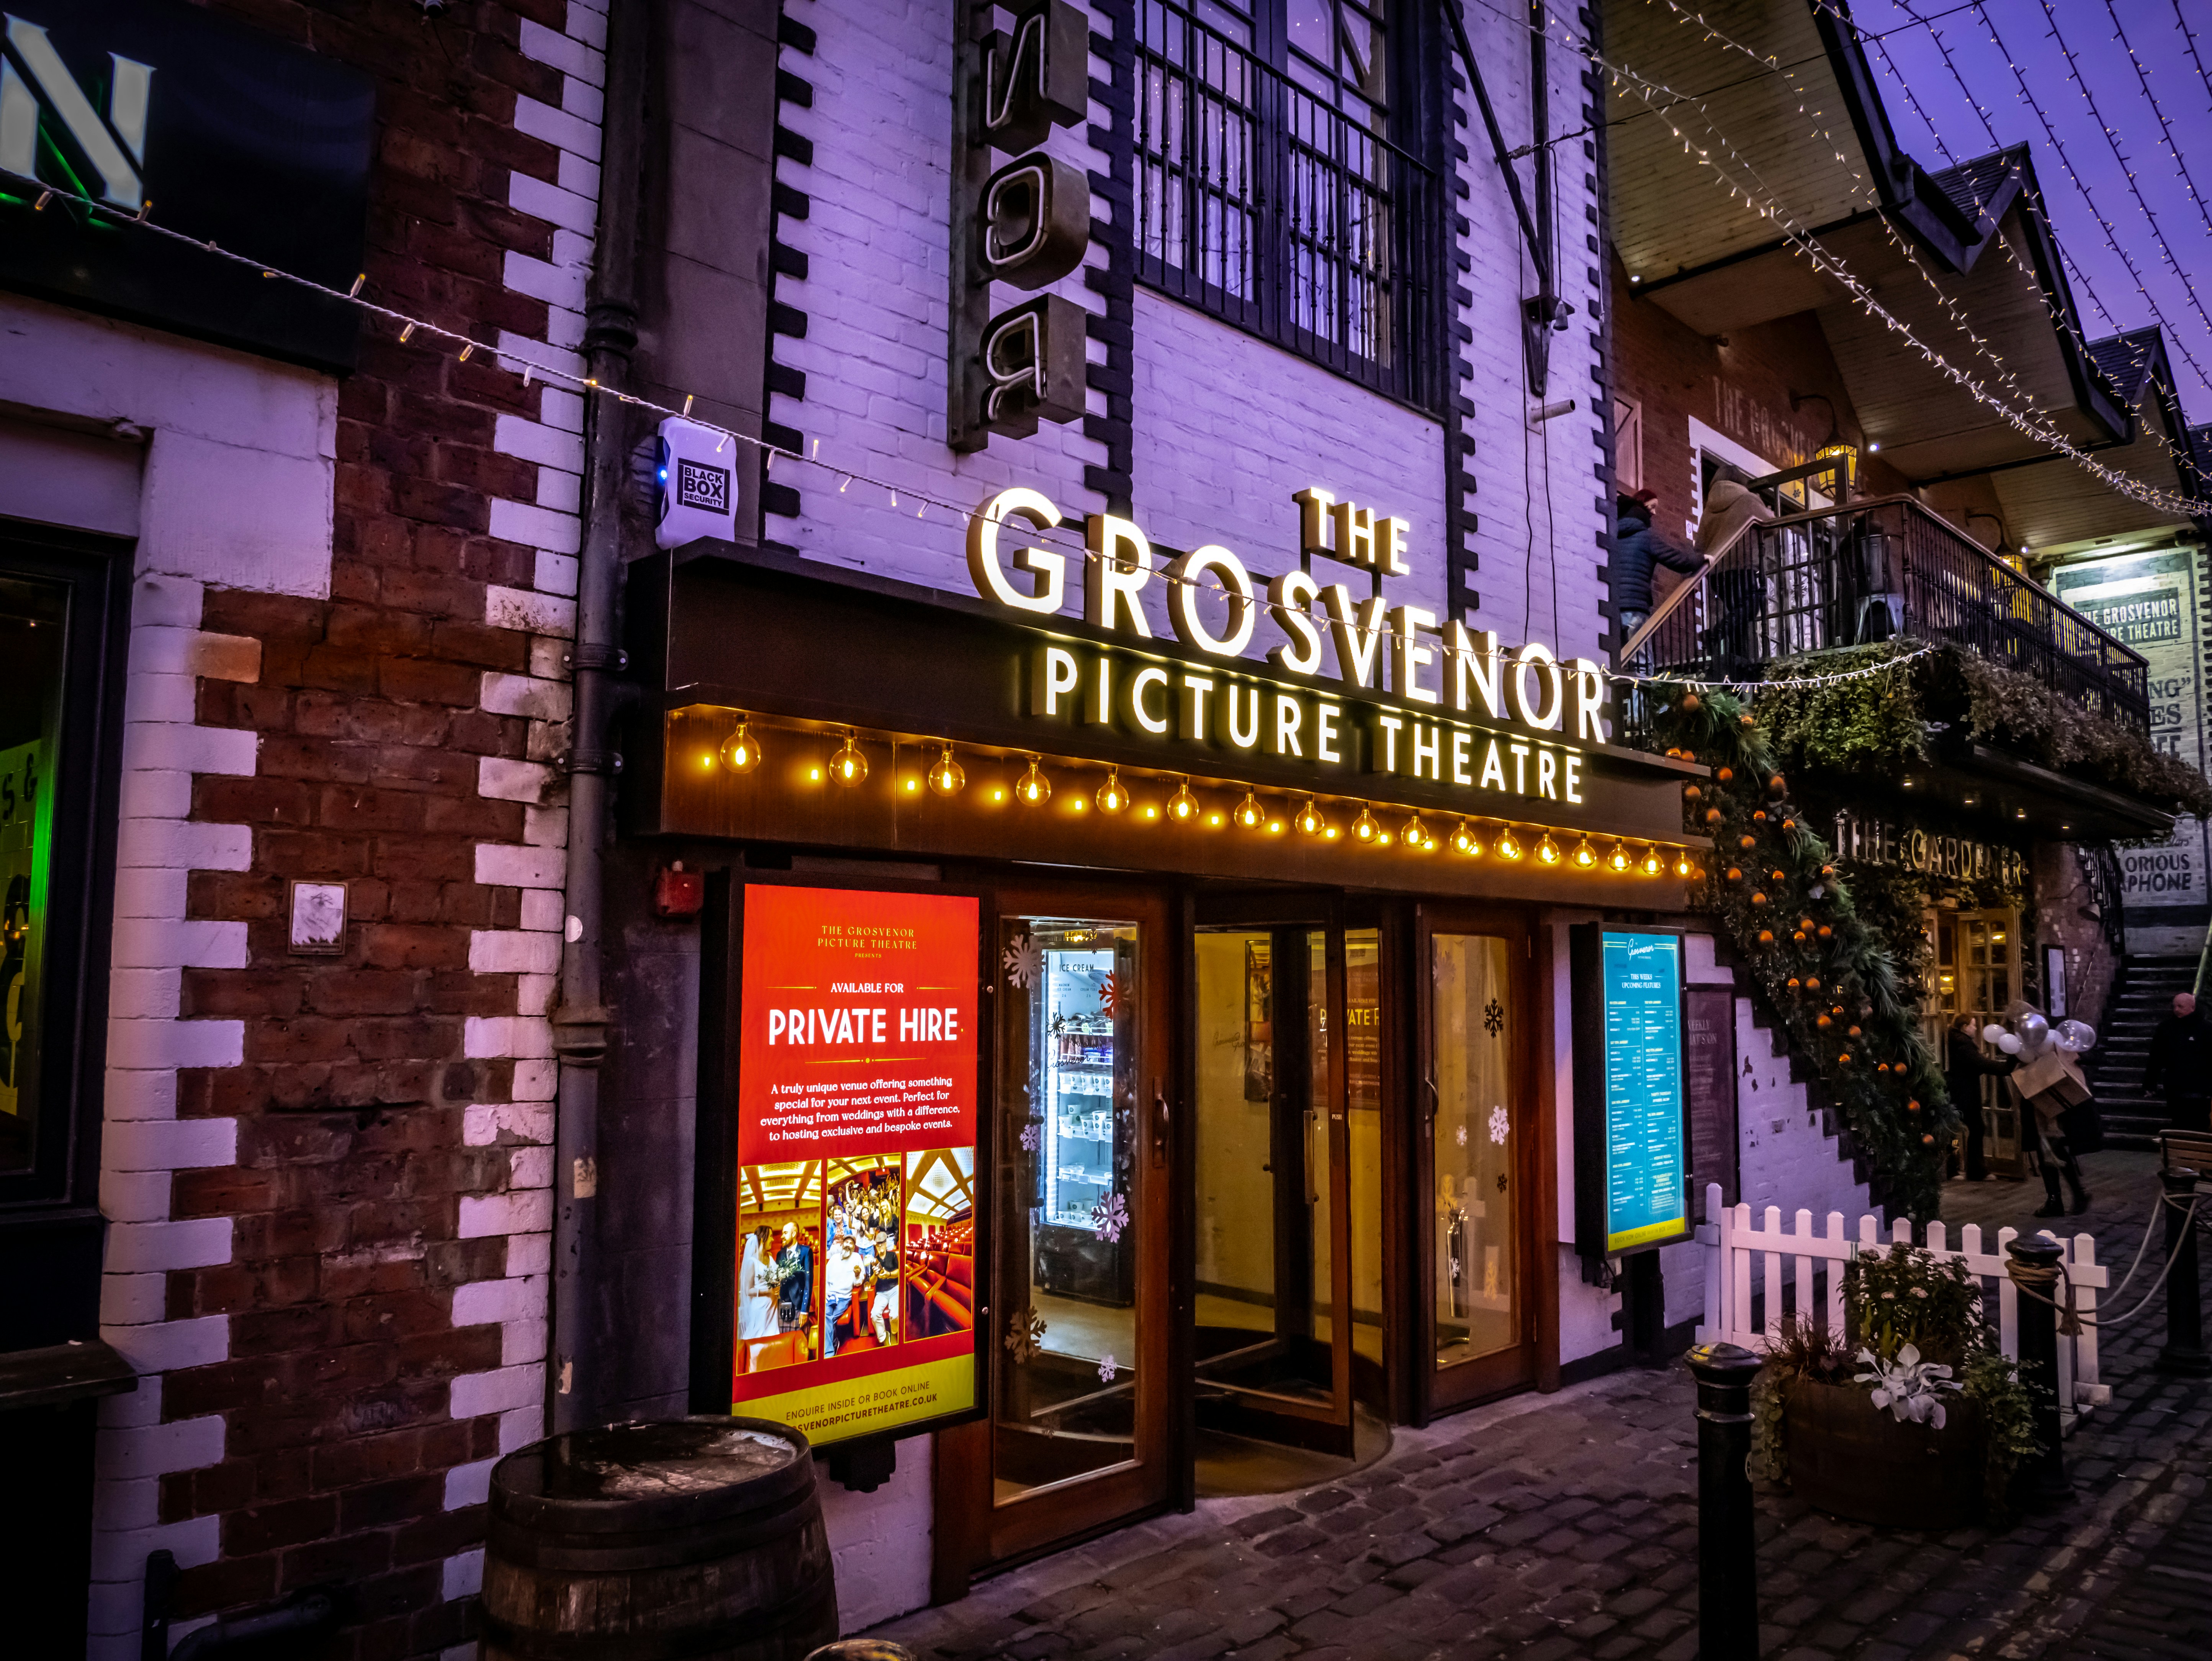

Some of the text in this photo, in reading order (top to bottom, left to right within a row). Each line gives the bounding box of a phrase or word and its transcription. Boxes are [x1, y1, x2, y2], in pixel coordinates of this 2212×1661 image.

[684, 467, 723, 485] BLACK
[684, 478, 723, 500] BOX
[684, 493, 722, 506] SECURITY
[1302, 487, 1410, 575] THE
[969, 488, 1605, 744] GROSVENOR
[2103, 598, 2178, 625] GROSVENOR
[2127, 619, 2178, 640] THEATRE
[1046, 647, 1340, 763] PICTURE
[1380, 716, 1582, 804] THEATRE
[2118, 854, 2190, 872] ORIOUS
[822, 926, 914, 937] THE GROSVENOR
[818, 939, 917, 949] PICTURE THEATRE
[1073, 964, 1094, 972] CREAM
[831, 983, 904, 993] AVAILABLE FOR
[769, 1008, 958, 1045] PRIVATE HIRE
[771, 1076, 952, 1095] A truly unique venue offering something
[774, 1091, 949, 1111] special for your next event. Perfect for
[760, 1113, 814, 1127] everything
[816, 1112, 839, 1122] from
[842, 1109, 884, 1120] weddings
[887, 1107, 905, 1117] with
[915, 1105, 960, 1116] difference,
[769, 1119, 952, 1141] to hosting exclusive and bespoke events.
[786, 1381, 930, 1420] ENQUIRE INSIDE OR BOOK ONLINE
